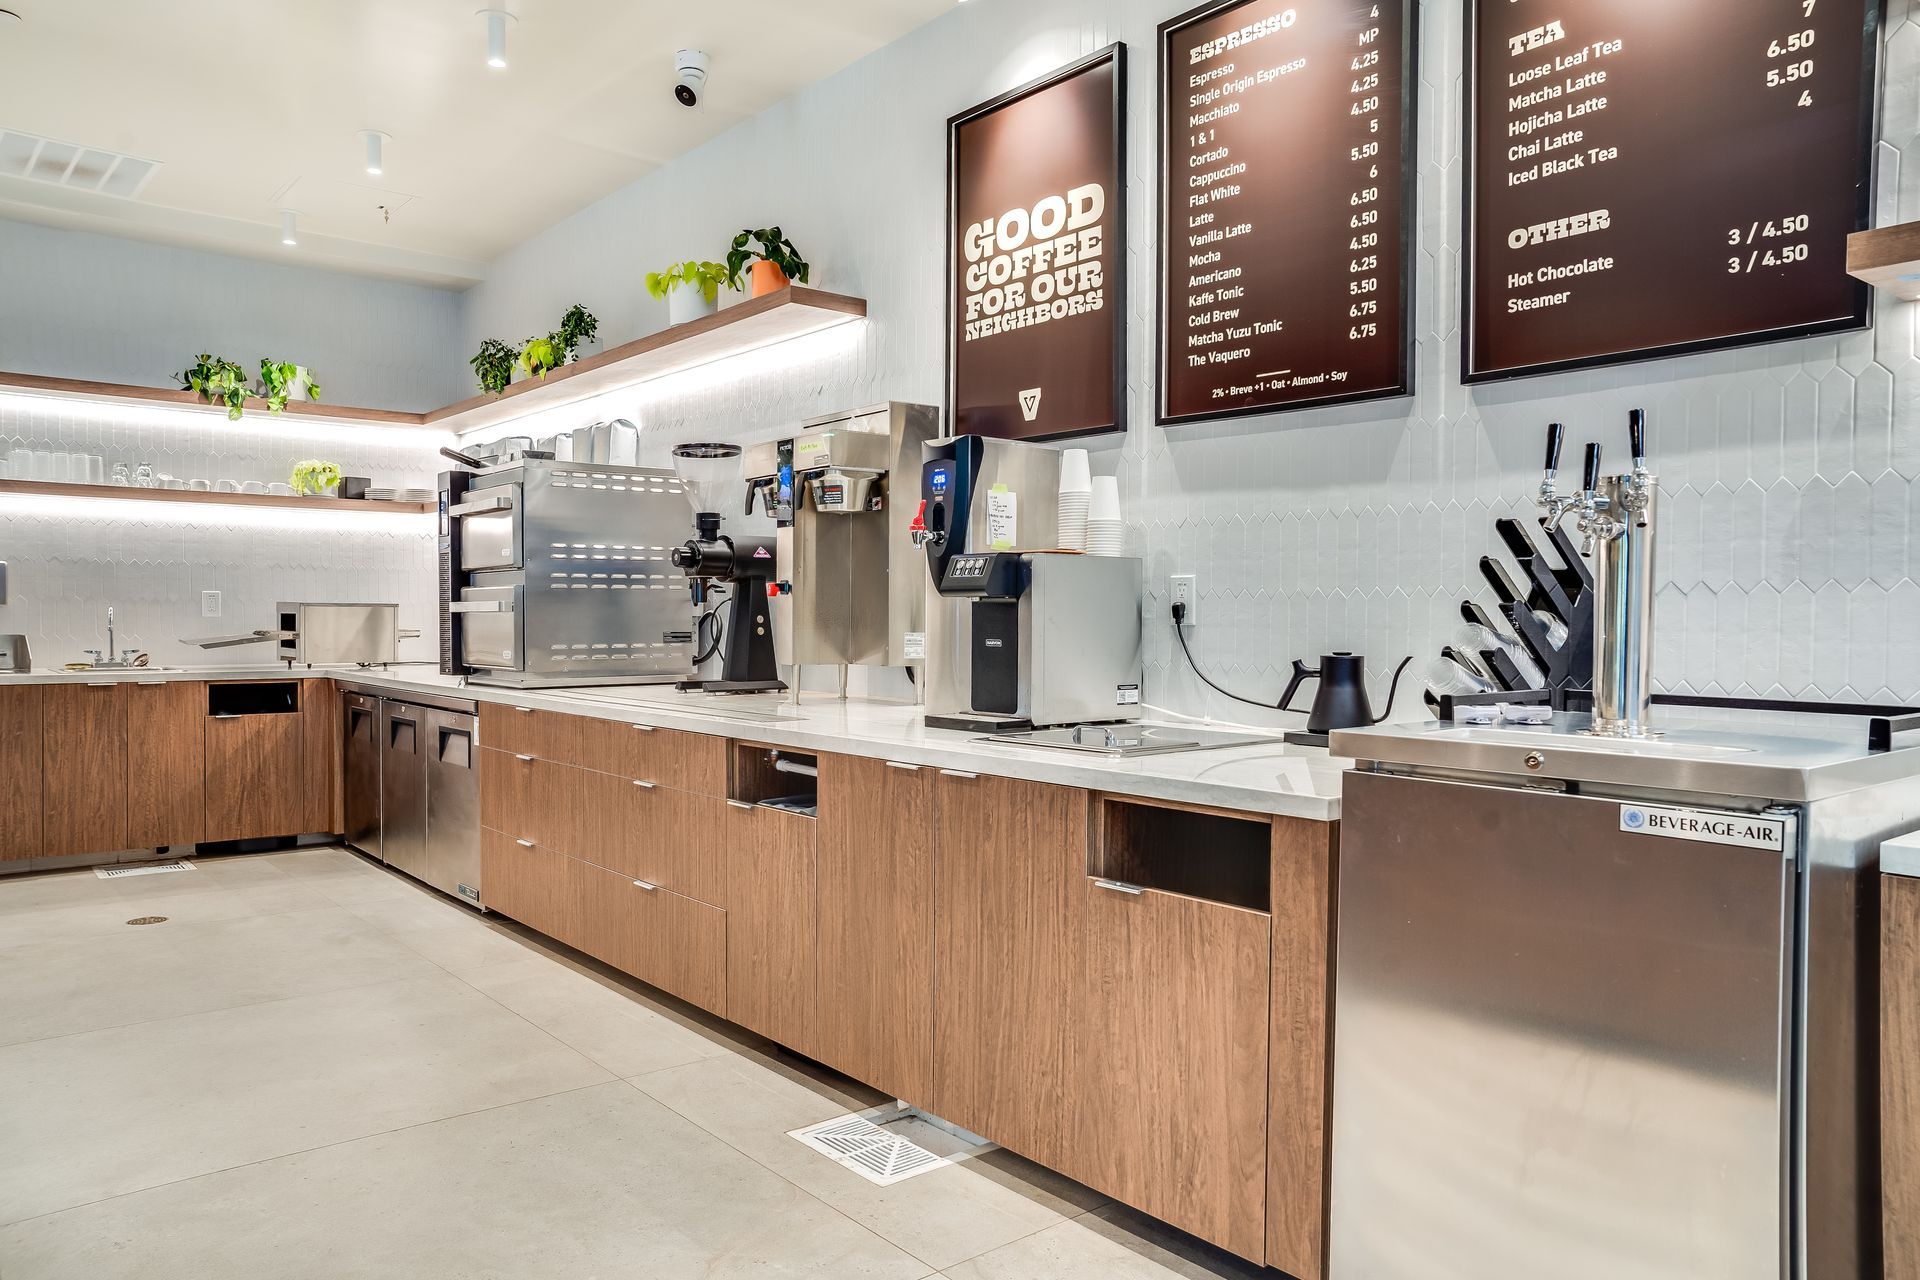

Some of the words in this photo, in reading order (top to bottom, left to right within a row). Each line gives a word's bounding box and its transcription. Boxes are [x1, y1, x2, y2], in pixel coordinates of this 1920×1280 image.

[1370, 4, 1379, 18] 4
[1802, 0, 1816, 17] 7
[1190, 8, 1296, 64] ESPRESSO
[1358, 27, 1379, 46] MP
[1508, 20, 1565, 56] TEA
[1767, 29, 1815, 58] 6.50
[1351, 50, 1379, 71] 4.25
[1509, 63, 1551, 87] Loose
[1555, 47, 1589, 72] Leaf
[1592, 37, 1622, 58] Tea
[1190, 62, 1234, 88] Espresso
[1190, 87, 1220, 107] Single
[1223, 75, 1254, 96] Origin
[1257, 57, 1306, 81] Espresso
[1351, 74, 1379, 94] 4.25
[1766, 59, 1813, 87] 5.50
[1508, 85, 1562, 112] Matcha
[1566, 69, 1606, 94] Latte
[1798, 90, 1812, 107] 4
[1190, 102, 1239, 127] Macchiato
[1351, 96, 1378, 116] 4.50
[1508, 109, 1563, 137] Hojicha
[1567, 95, 1607, 119] Latte
[1370, 119, 1378, 133] 5
[1190, 135, 1195, 147] 1
[1199, 132, 1206, 144] &
[1210, 129, 1214, 141] 1
[1508, 139, 1540, 161] Chai
[1544, 129, 1583, 152] Latte
[1190, 146, 1228, 167] Cortado
[1351, 142, 1378, 161] 5.50
[1190, 162, 1246, 187] Cappuccino
[1369, 165, 1378, 178] 6
[1508, 166, 1538, 186] Iced
[1542, 153, 1584, 177] Black
[1588, 145, 1618, 164] Tea
[1190, 192, 1208, 207] Flat
[1211, 184, 1240, 202] White
[1351, 187, 1378, 206] 6.50
[964, 183, 1105, 262] GOOD
[1189, 212, 1214, 227] Latte
[1350, 210, 1378, 228] 6.50
[1507, 208, 1611, 250] OTHER
[1727, 229, 1741, 245] 3
[1762, 215, 1809, 239] 4.50
[1189, 230, 1223, 247] Vanilla
[1225, 223, 1252, 239] Latte
[1350, 233, 1378, 250] 4.50
[966, 225, 1102, 291] COFFEE
[1189, 250, 1220, 267] Mocha
[1350, 255, 1377, 273] 6.25
[1727, 257, 1740, 274] 3
[1761, 244, 1808, 267] 4.50
[1189, 267, 1241, 287] Americano
[1508, 272, 1533, 288] Hot
[1537, 255, 1613, 284] Chocolate
[966, 281, 1025, 321] FOR
[1031, 261, 1103, 302] OUR
[1189, 291, 1214, 307] Kaffe
[1217, 285, 1244, 301] Tonic
[1350, 278, 1377, 295] 5.50
[1350, 300, 1376, 317] 6.75
[1507, 291, 1570, 313] Steamer
[965, 290, 1103, 342] NEIGHBORS
[1189, 310, 1210, 327] Cold
[1213, 309, 1239, 323] Brew
[1189, 329, 1223, 347] Matcha
[1226, 328, 1251, 341] Yuzu
[1253, 319, 1282, 335] Tonic
[1350, 323, 1376, 339] 6.75
[1188, 354, 1206, 367] The
[1208, 348, 1250, 364] Vaquero
[1212, 389, 1224, 398] 2%
[1230, 383, 1252, 396] Breve
[1254, 382, 1264, 392] +1
[1271, 379, 1285, 389] Oat
[1292, 373, 1323, 386] Almond
[1331, 371, 1347, 382] Soy
[1650, 814, 1773, 842] BEVERAGE-AIR
